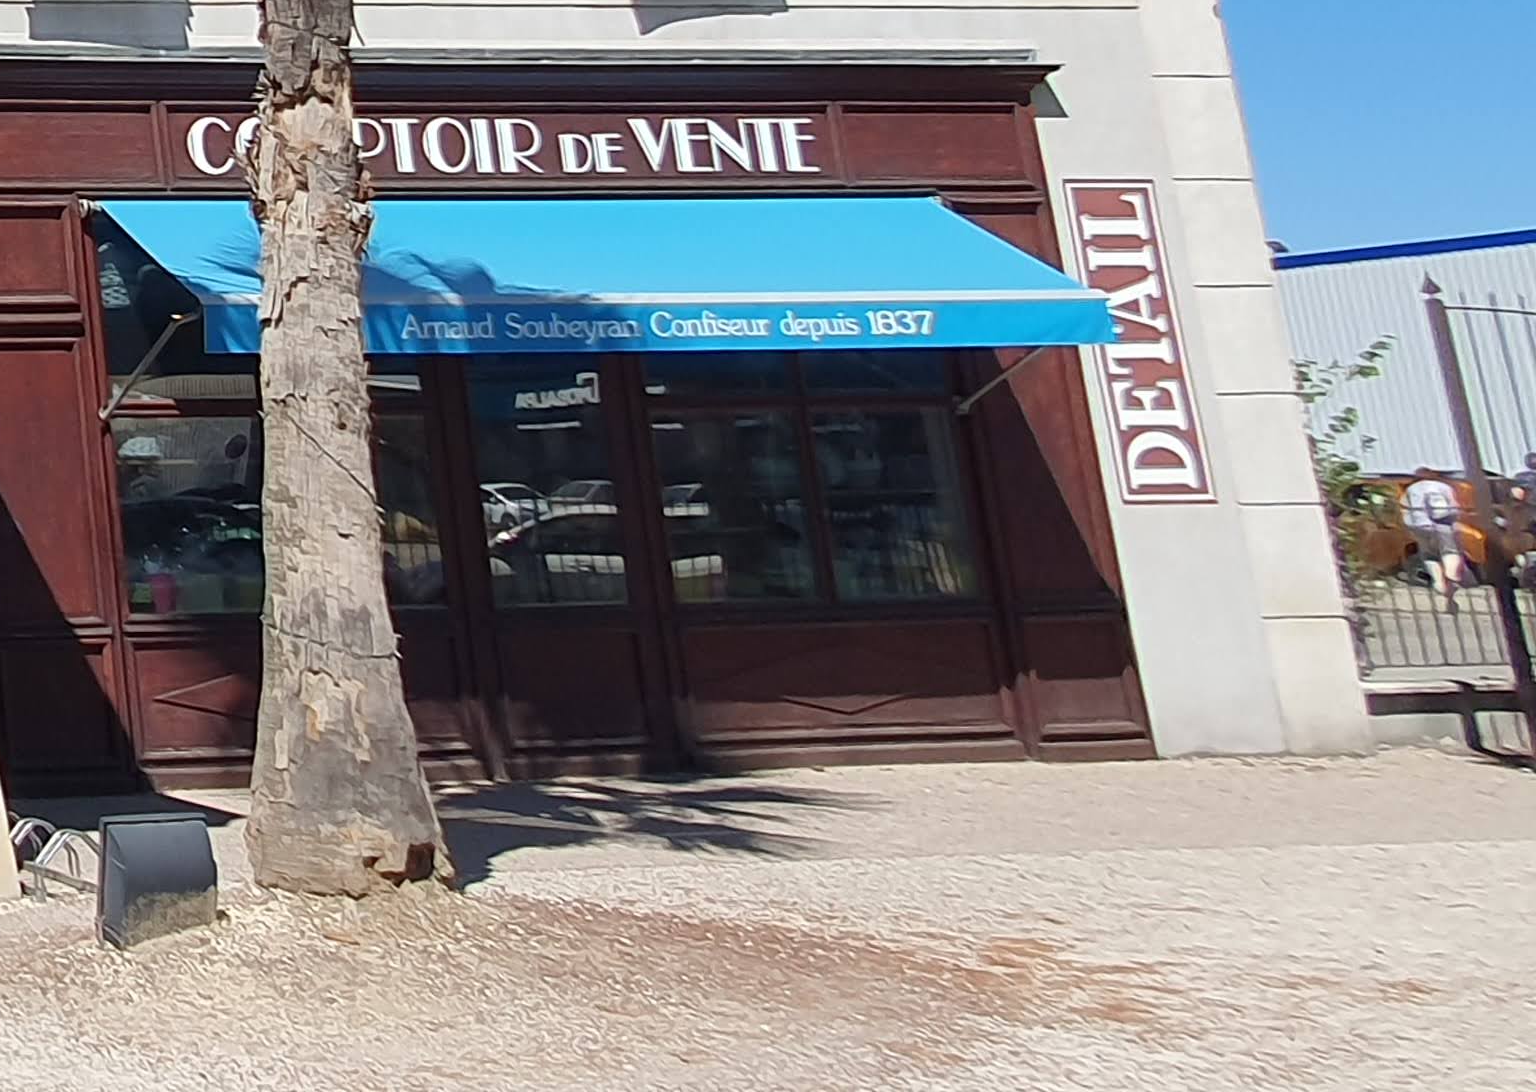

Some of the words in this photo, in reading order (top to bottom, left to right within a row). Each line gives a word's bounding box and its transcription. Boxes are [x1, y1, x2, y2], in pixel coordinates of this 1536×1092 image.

[559, 132, 626, 174] DE
[628, 117, 822, 174] VENTE
[400, 313, 494, 341] Arnaud
[504, 311, 639, 346] Soubeyran
[650, 310, 771, 339] Confiseur
[779, 310, 860, 345] depuis
[866, 309, 933, 337] 1837
[1080, 192, 1200, 490] DETAIL
